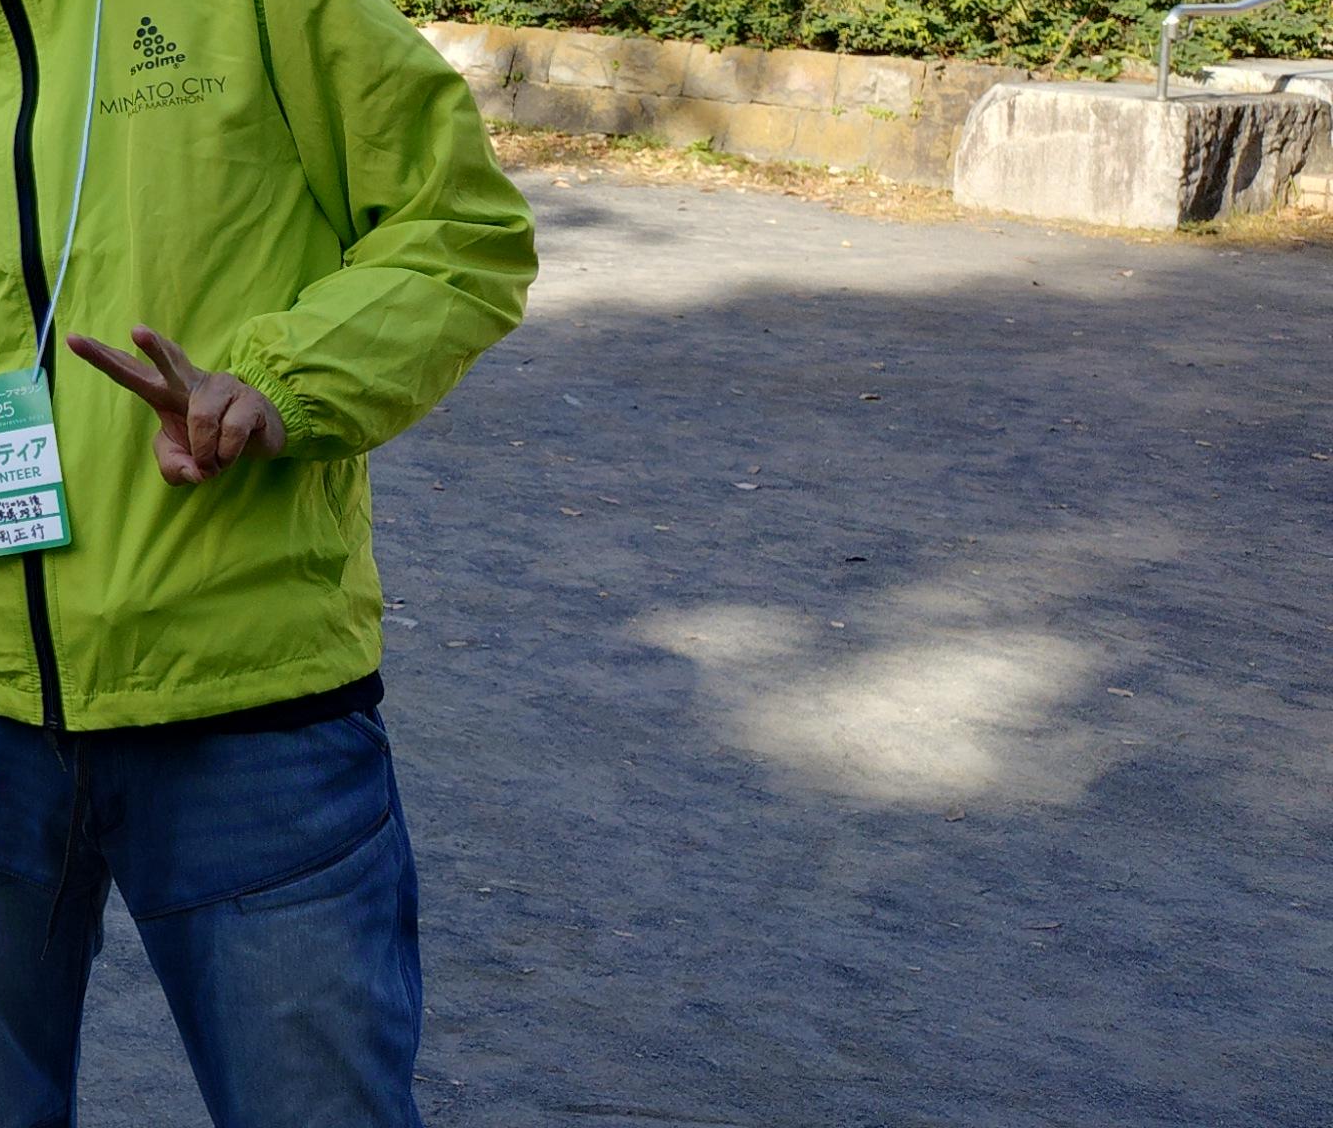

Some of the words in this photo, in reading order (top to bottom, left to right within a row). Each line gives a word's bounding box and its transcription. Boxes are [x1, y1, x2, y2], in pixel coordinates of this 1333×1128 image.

[130, 53, 186, 76] svolme
[100, 81, 174, 114] MINATO
[182, 76, 226, 95] CITY
[145, 95, 204, 111] MARATHON
